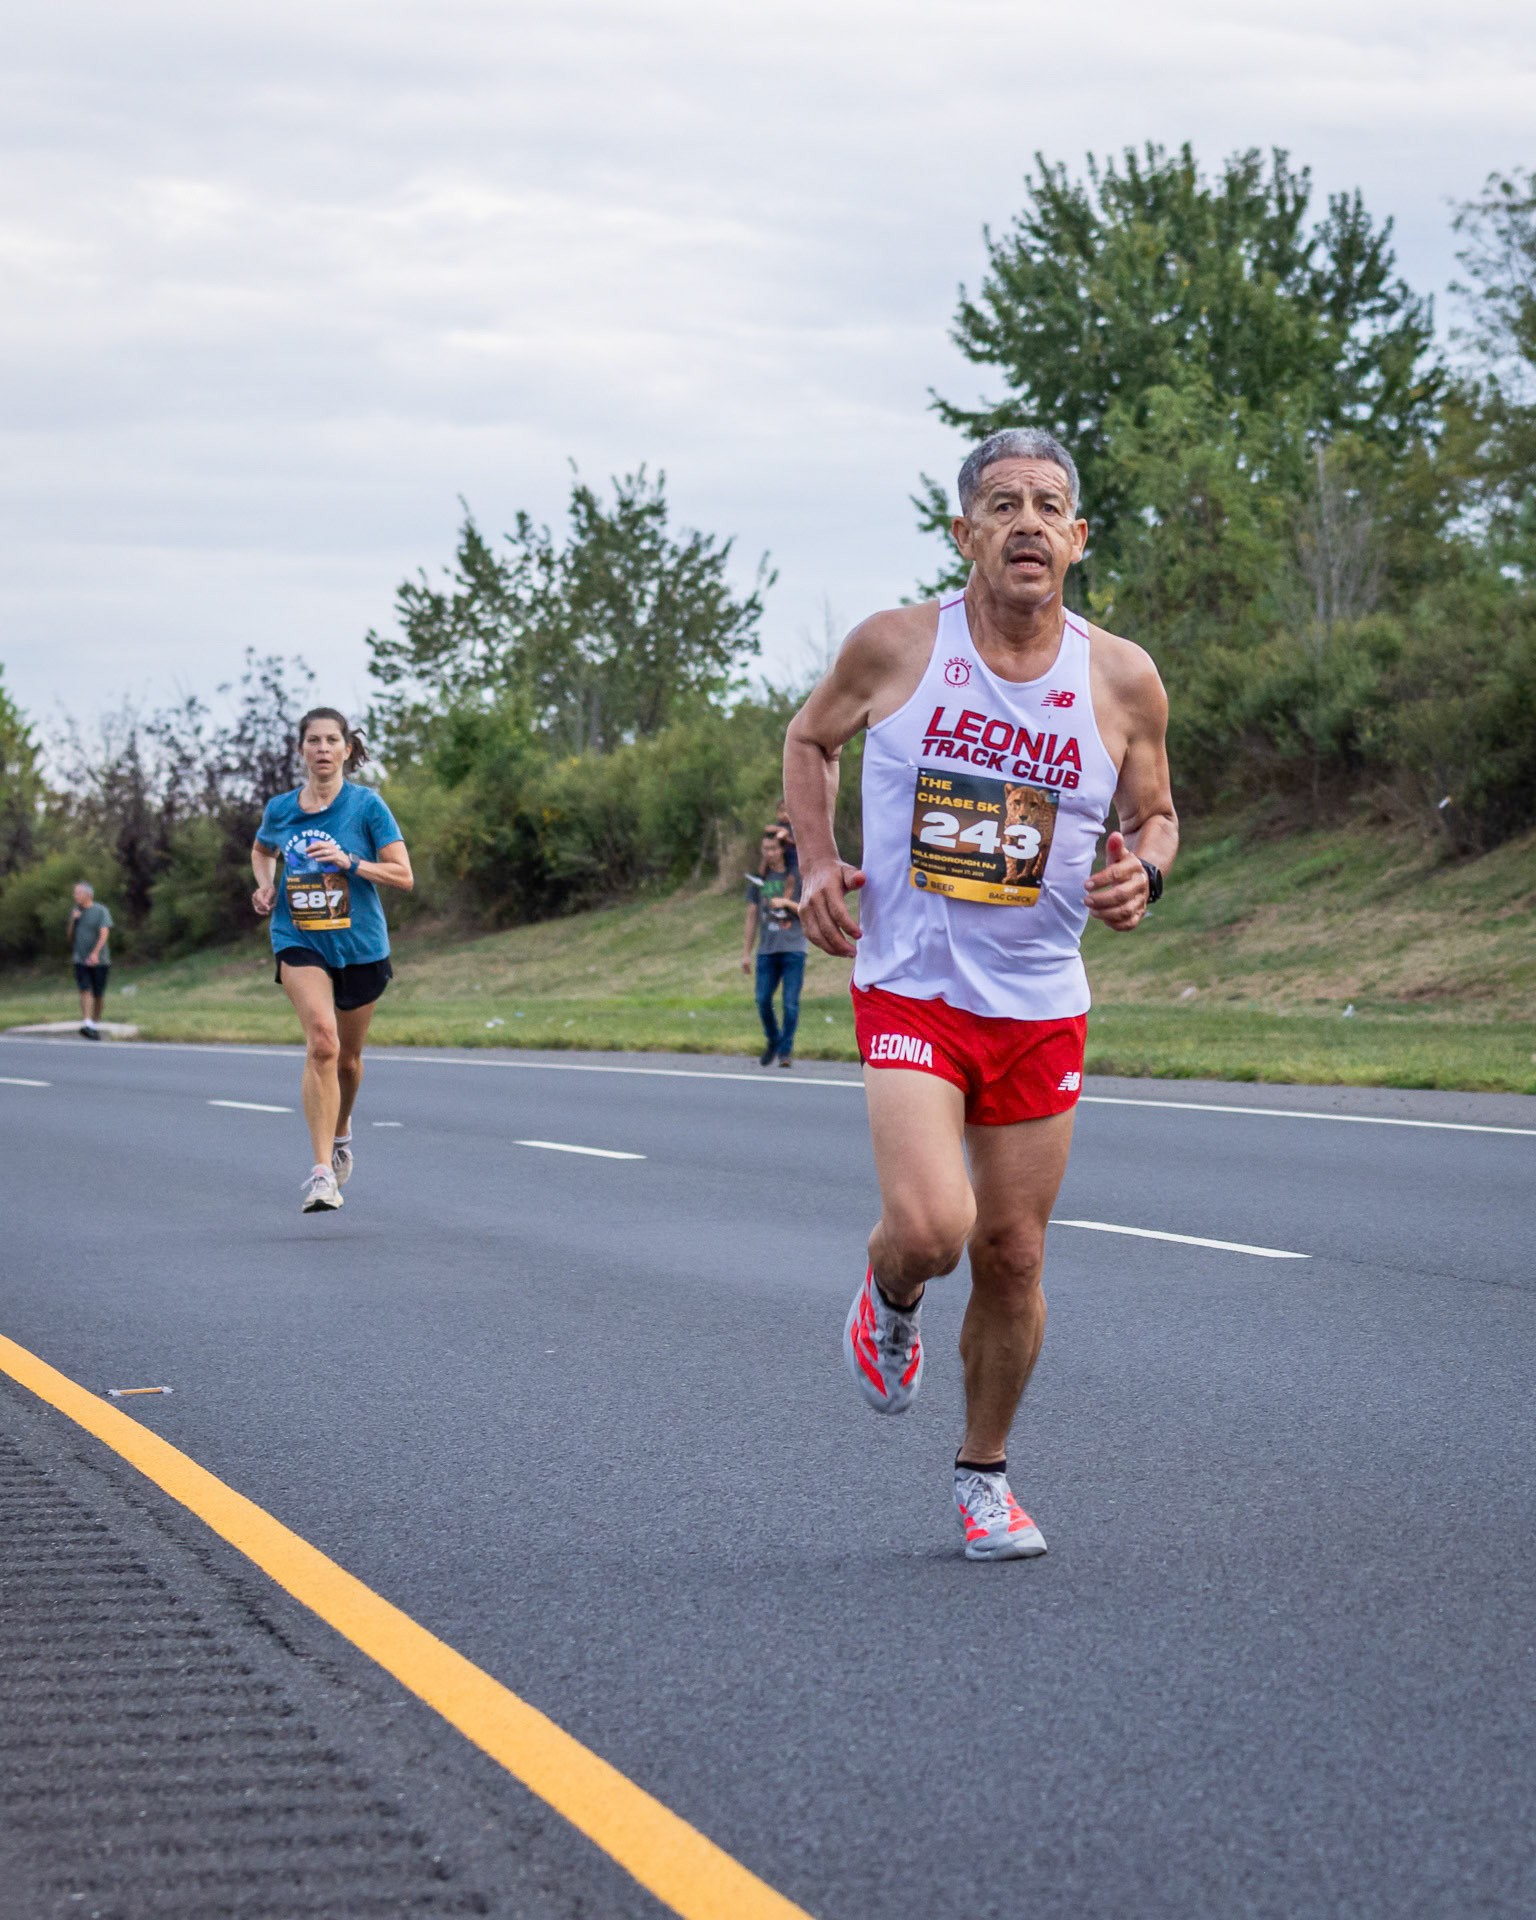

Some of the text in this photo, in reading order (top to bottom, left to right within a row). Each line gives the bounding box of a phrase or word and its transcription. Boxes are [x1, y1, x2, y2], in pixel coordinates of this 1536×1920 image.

[944, 656, 973, 670] LEONIA
[924, 706, 1082, 772] LEONIA
[921, 739, 1081, 790] TRACK CLUB
[920, 776, 952, 790] THE
[917, 792, 1001, 815] CHASE 5K
[920, 811, 1041, 860] 243
[930, 881, 954, 892] BEER
[292, 890, 343, 908] 287
[1006, 894, 1032, 903] CHECK
[869, 1033, 933, 1069] LEONIA
